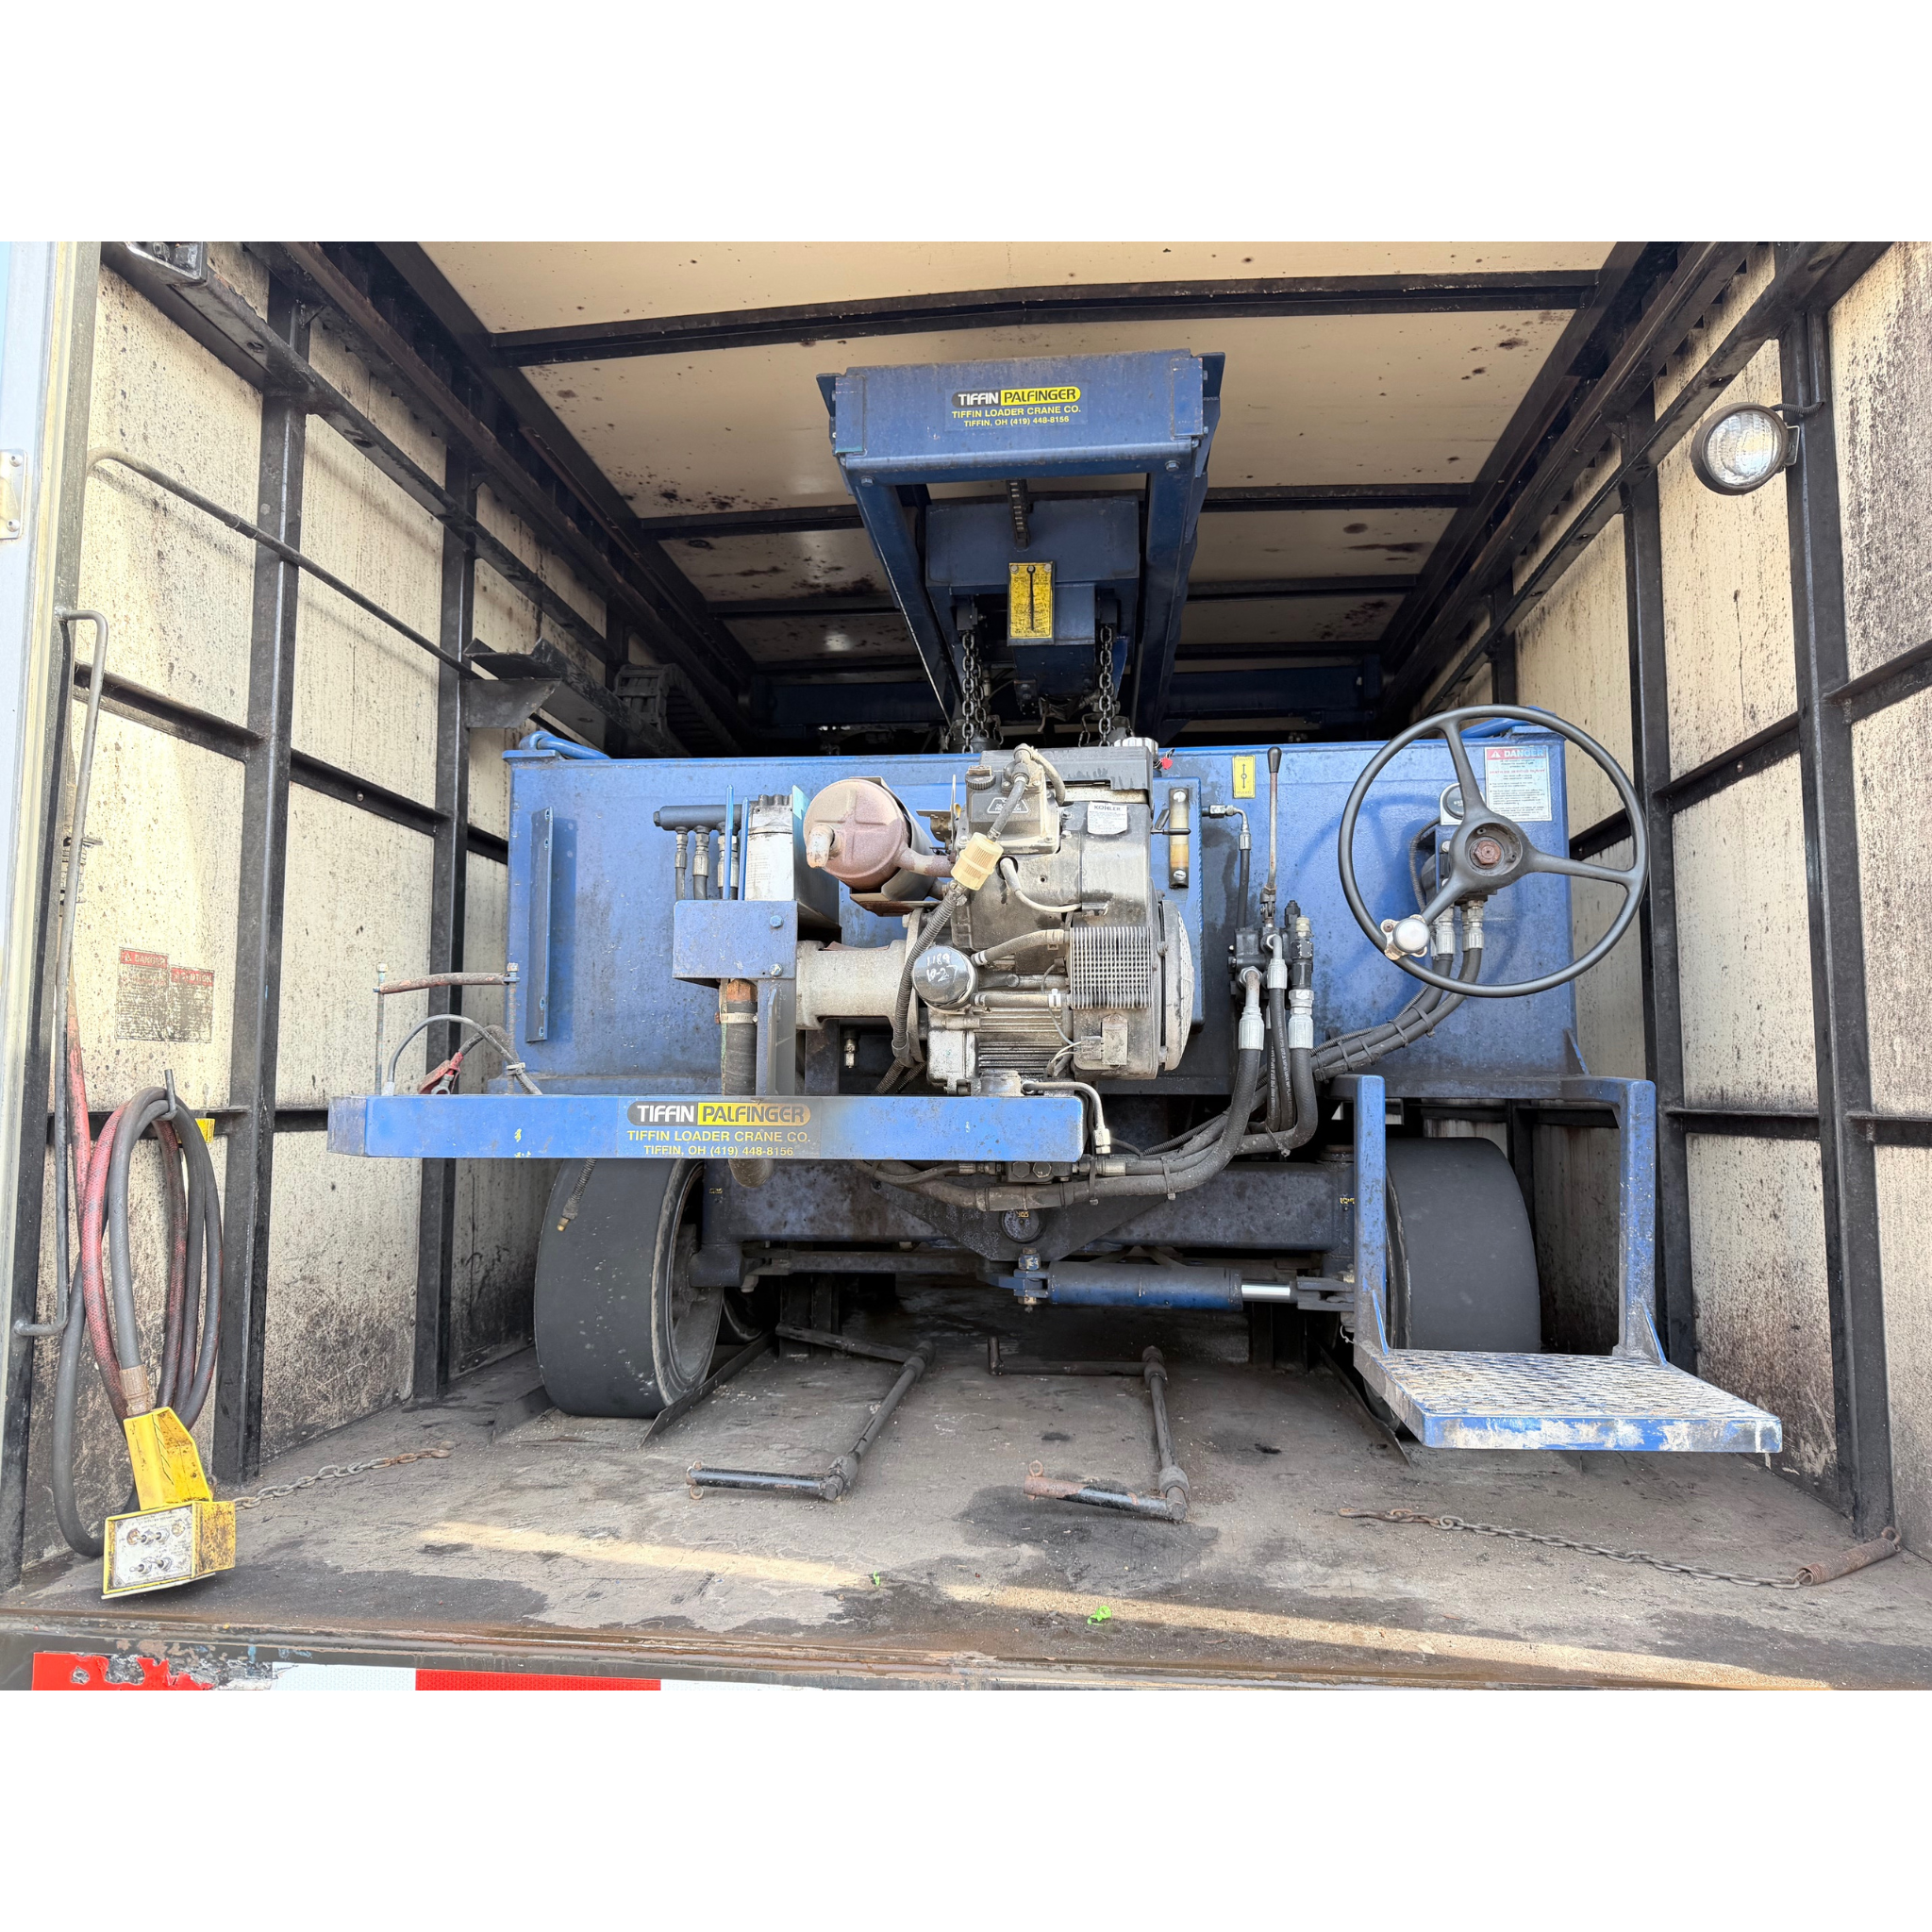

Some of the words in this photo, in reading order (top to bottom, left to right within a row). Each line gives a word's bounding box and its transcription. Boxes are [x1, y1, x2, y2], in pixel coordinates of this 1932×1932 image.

[958, 391, 999, 406] TIFFIN
[1004, 388, 1076, 404] PALFINGER
[951, 409, 982, 419] TIFFIN
[985, 408, 1024, 417] LOADER
[1026, 406, 1061, 415] CRANE
[1063, 405, 1081, 413] CO.
[1009, 417, 1030, 426] (419)
[1504, 749, 1543, 758] DANGER
[926, 953, 951, 967] 1189
[637, 1105, 695, 1123] TIFFIN
[702, 1105, 806, 1123] PALFINGER
[626, 1130, 670, 1141] TIFFIN
[675, 1130, 730, 1142] LOADER
[734, 1131, 783, 1142] CRANE
[787, 1131, 811, 1142] CO.
[643, 1145, 684, 1157] TIFFIN,
[688, 1145, 707, 1156] OH
[709, 1146, 739, 1158] (419)
[741, 1146, 793, 1157] 448-8156
